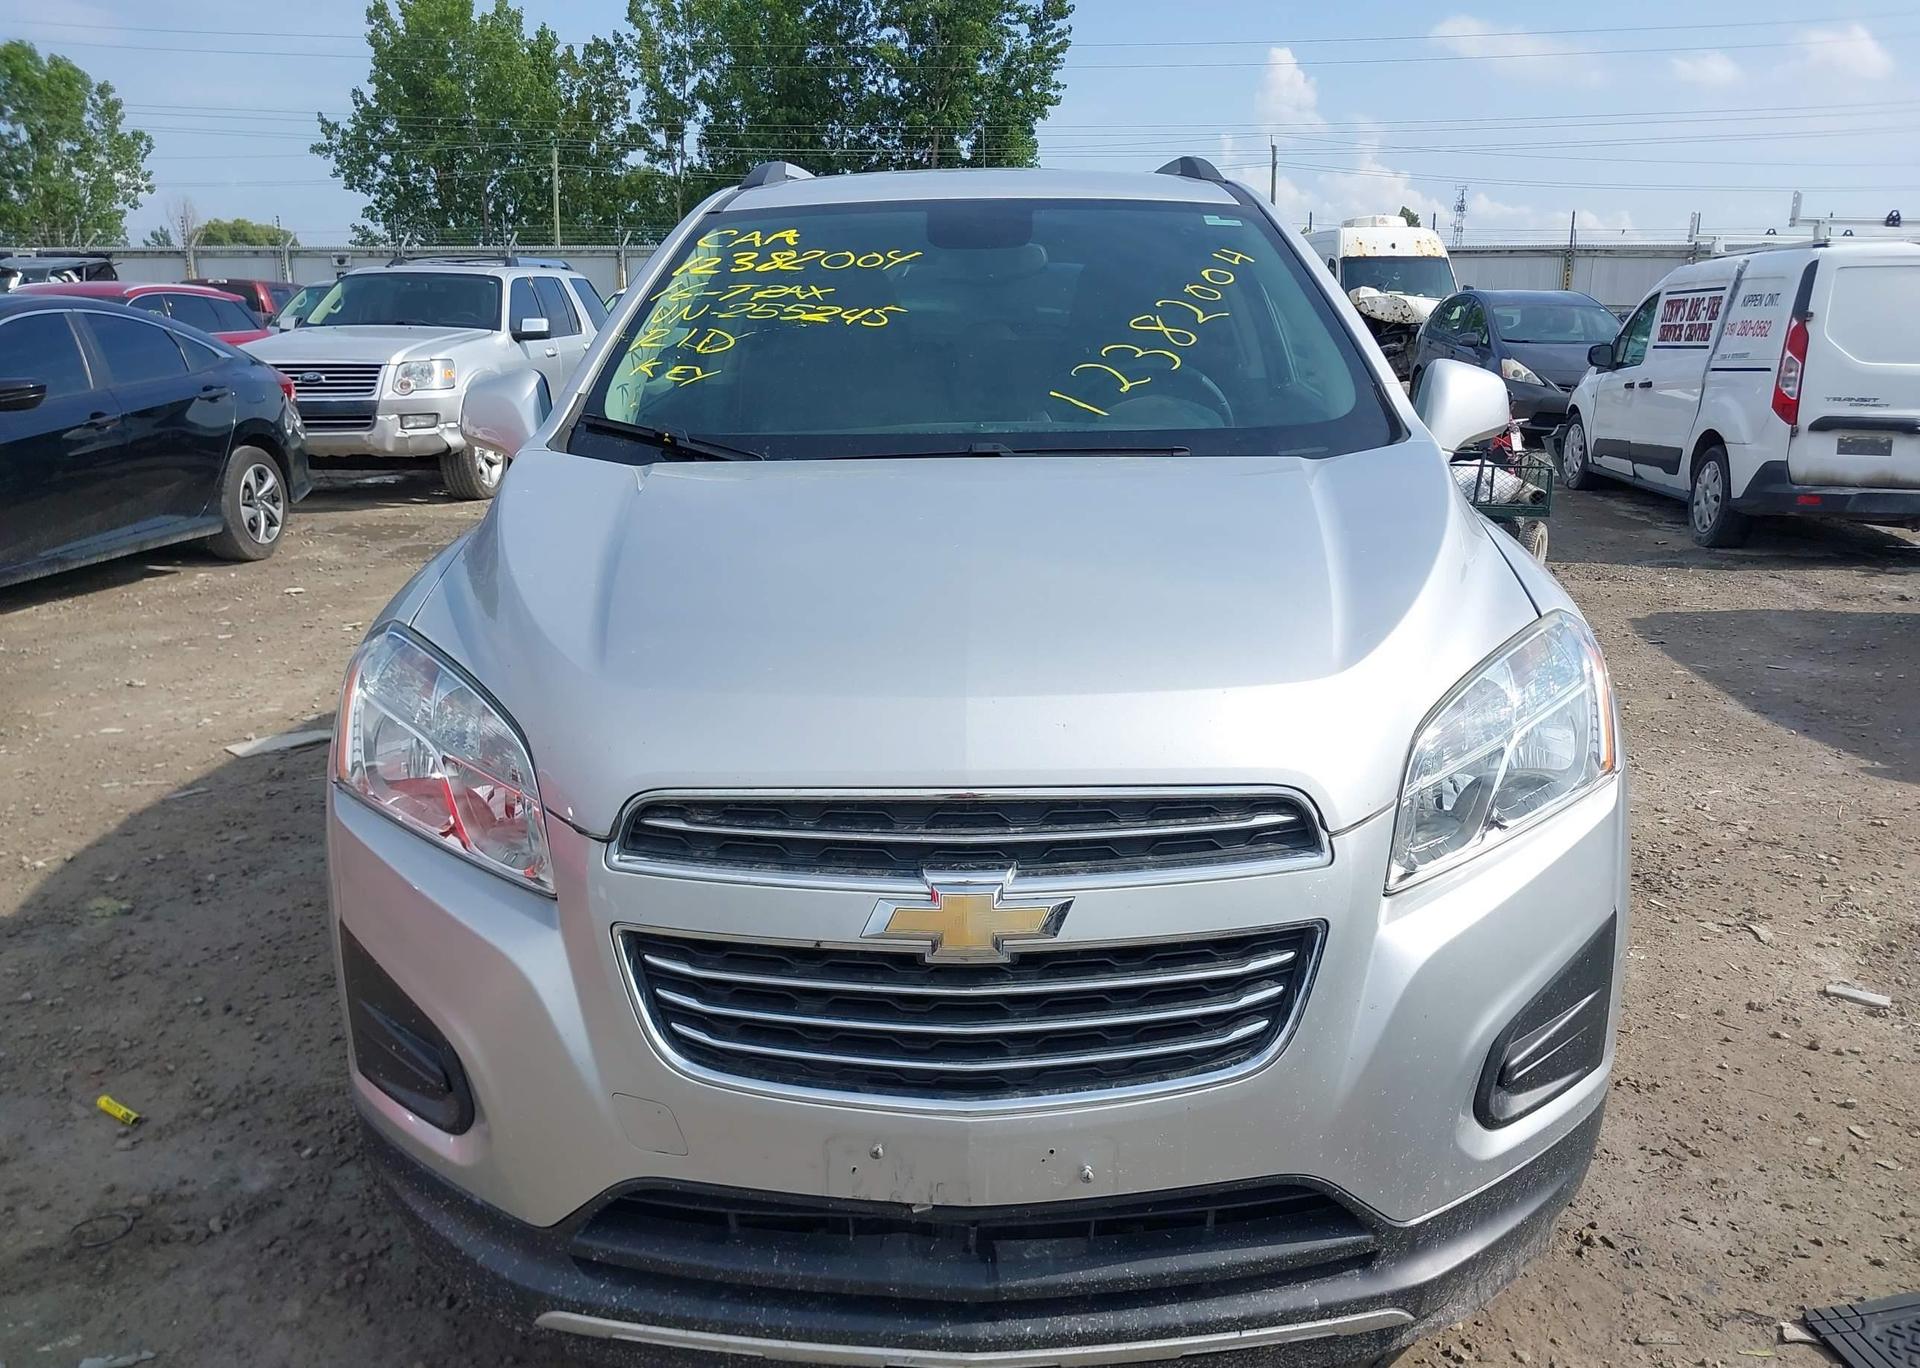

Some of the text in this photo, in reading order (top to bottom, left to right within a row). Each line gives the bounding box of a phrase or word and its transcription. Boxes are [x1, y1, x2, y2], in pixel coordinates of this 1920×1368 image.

[1741, 293, 1765, 308] KIPPEN
[1048, 247, 1256, 417] 12382004
[1657, 322, 1713, 342] SERVICE CENTRE
[629, 356, 723, 388] KEY
